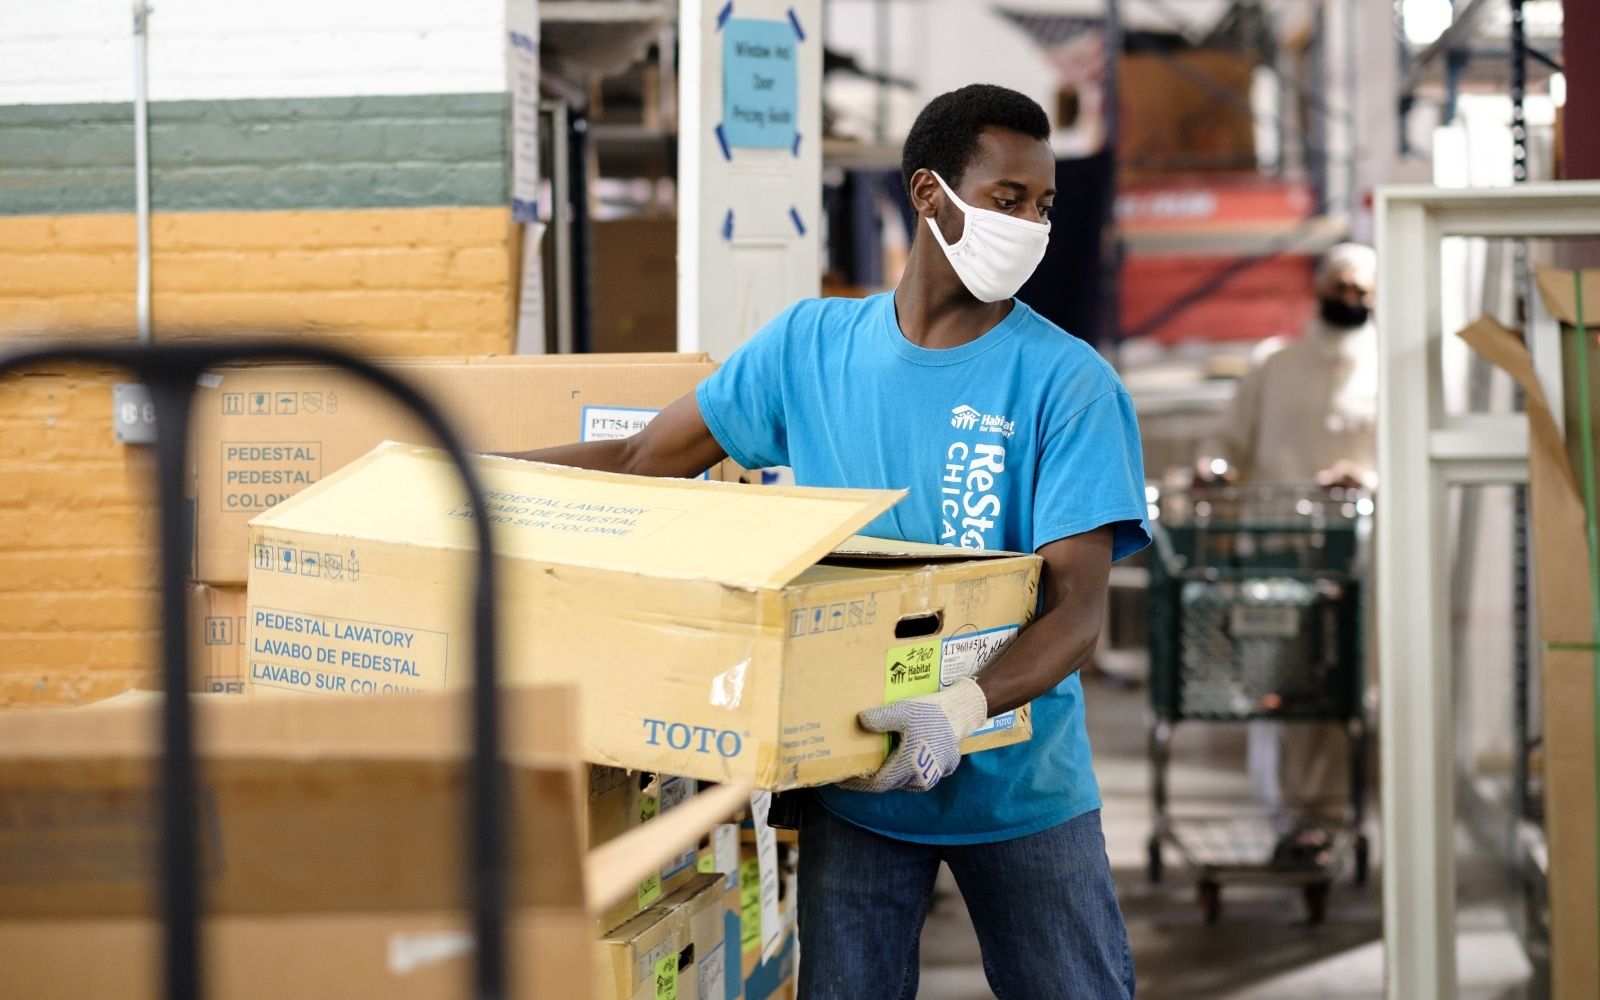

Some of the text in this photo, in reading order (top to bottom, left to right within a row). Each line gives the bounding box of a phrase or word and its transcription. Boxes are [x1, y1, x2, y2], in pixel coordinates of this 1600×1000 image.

[592, 418, 629, 430] PT754
[227, 447, 315, 461] PEDESTAL
[227, 470, 315, 484] PEDESTAL
[482, 490, 650, 516] PEDESTAL LAVATORY
[941, 442, 969, 549] CHICA
[513, 517, 551, 529] SUR
[551, 522, 634, 537] COLONNE
[530, 508, 557, 518] DE
[557, 512, 639, 528] PEDESTAL
[255, 611, 415, 649] PEDESTAL LAVATORY
[254, 638, 421, 678] LAVABO DE PEDESTAL
[906, 647, 935, 663] #960
[252, 663, 311, 687] LAVABO
[315, 673, 346, 692] SUR
[907, 663, 931, 676] Habitat
[995, 716, 1013, 727] TOTO
[643, 718, 743, 758] TOTO
